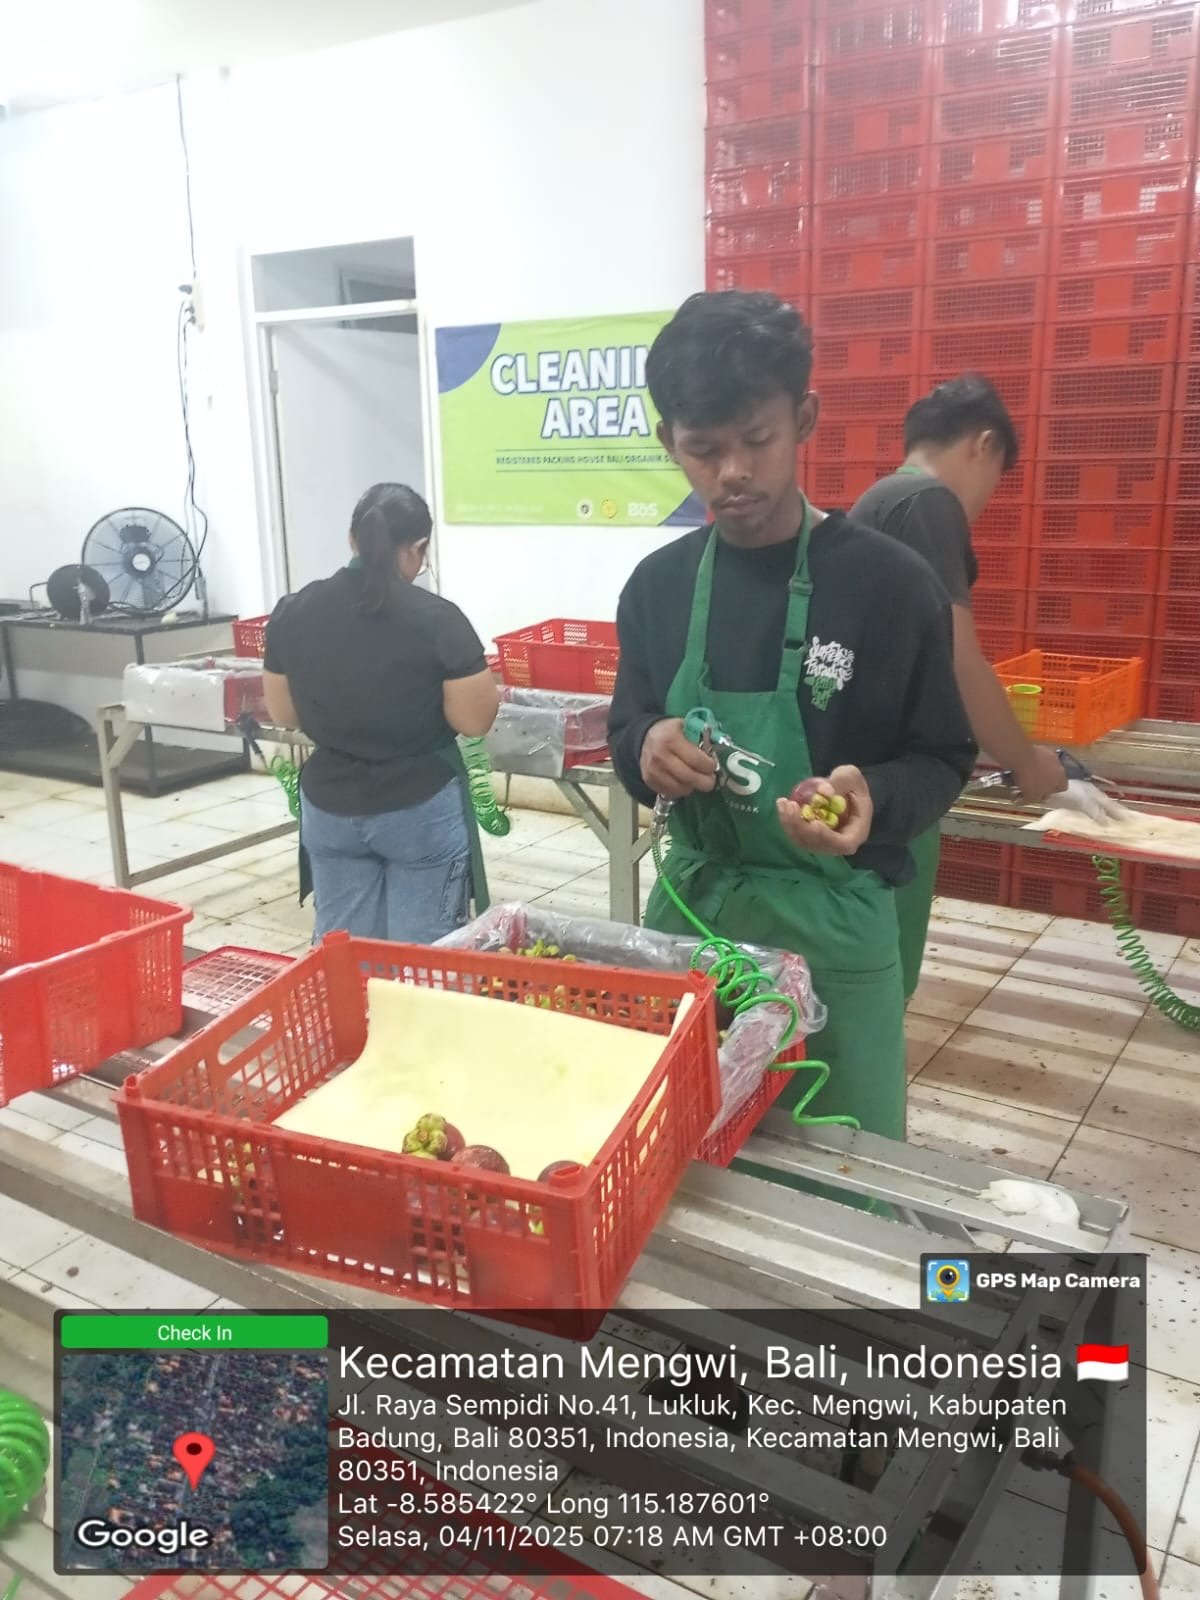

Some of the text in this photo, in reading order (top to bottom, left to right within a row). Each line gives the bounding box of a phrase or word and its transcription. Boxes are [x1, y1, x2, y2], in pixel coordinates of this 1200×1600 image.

[541, 395, 651, 439] AREA
[496, 455, 542, 465] REGISTERED
[543, 455, 576, 465] PACKING
[577, 455, 605, 464] HOUSE
[607, 454, 624, 464] BALI
[625, 454, 664, 464] ORGANIK
